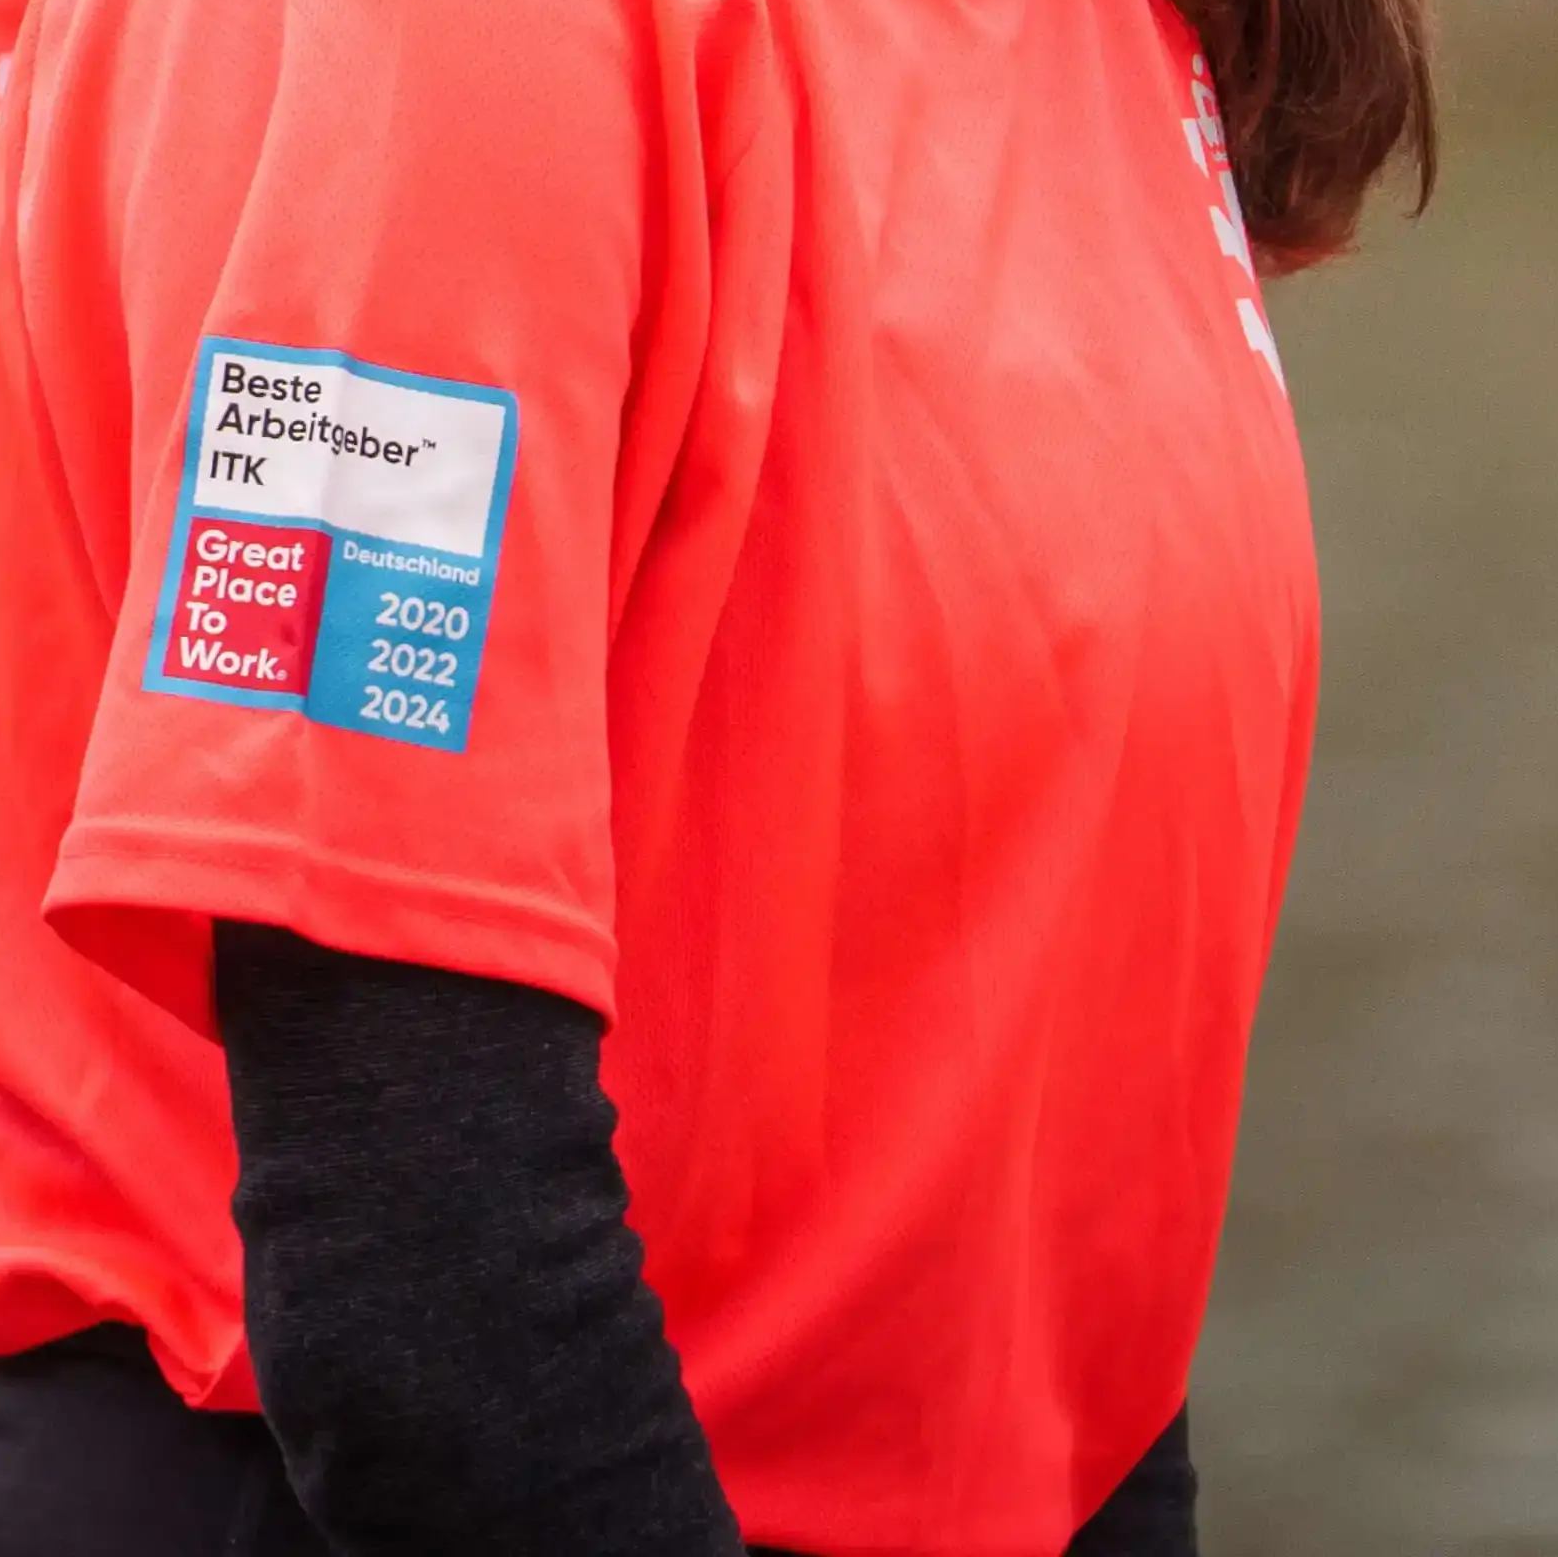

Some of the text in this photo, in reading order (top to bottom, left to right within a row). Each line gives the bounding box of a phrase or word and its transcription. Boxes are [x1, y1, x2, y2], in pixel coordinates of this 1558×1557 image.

[221, 362, 322, 404] Beste
[209, 450, 267, 486] ITK
[196, 530, 305, 571] Great
[343, 540, 480, 586] Deutschland
[192, 566, 297, 608] Place
[186, 601, 227, 634] To
[375, 591, 470, 641] 2020
[367, 638, 458, 687] 2022
[360, 685, 451, 734] 2024
